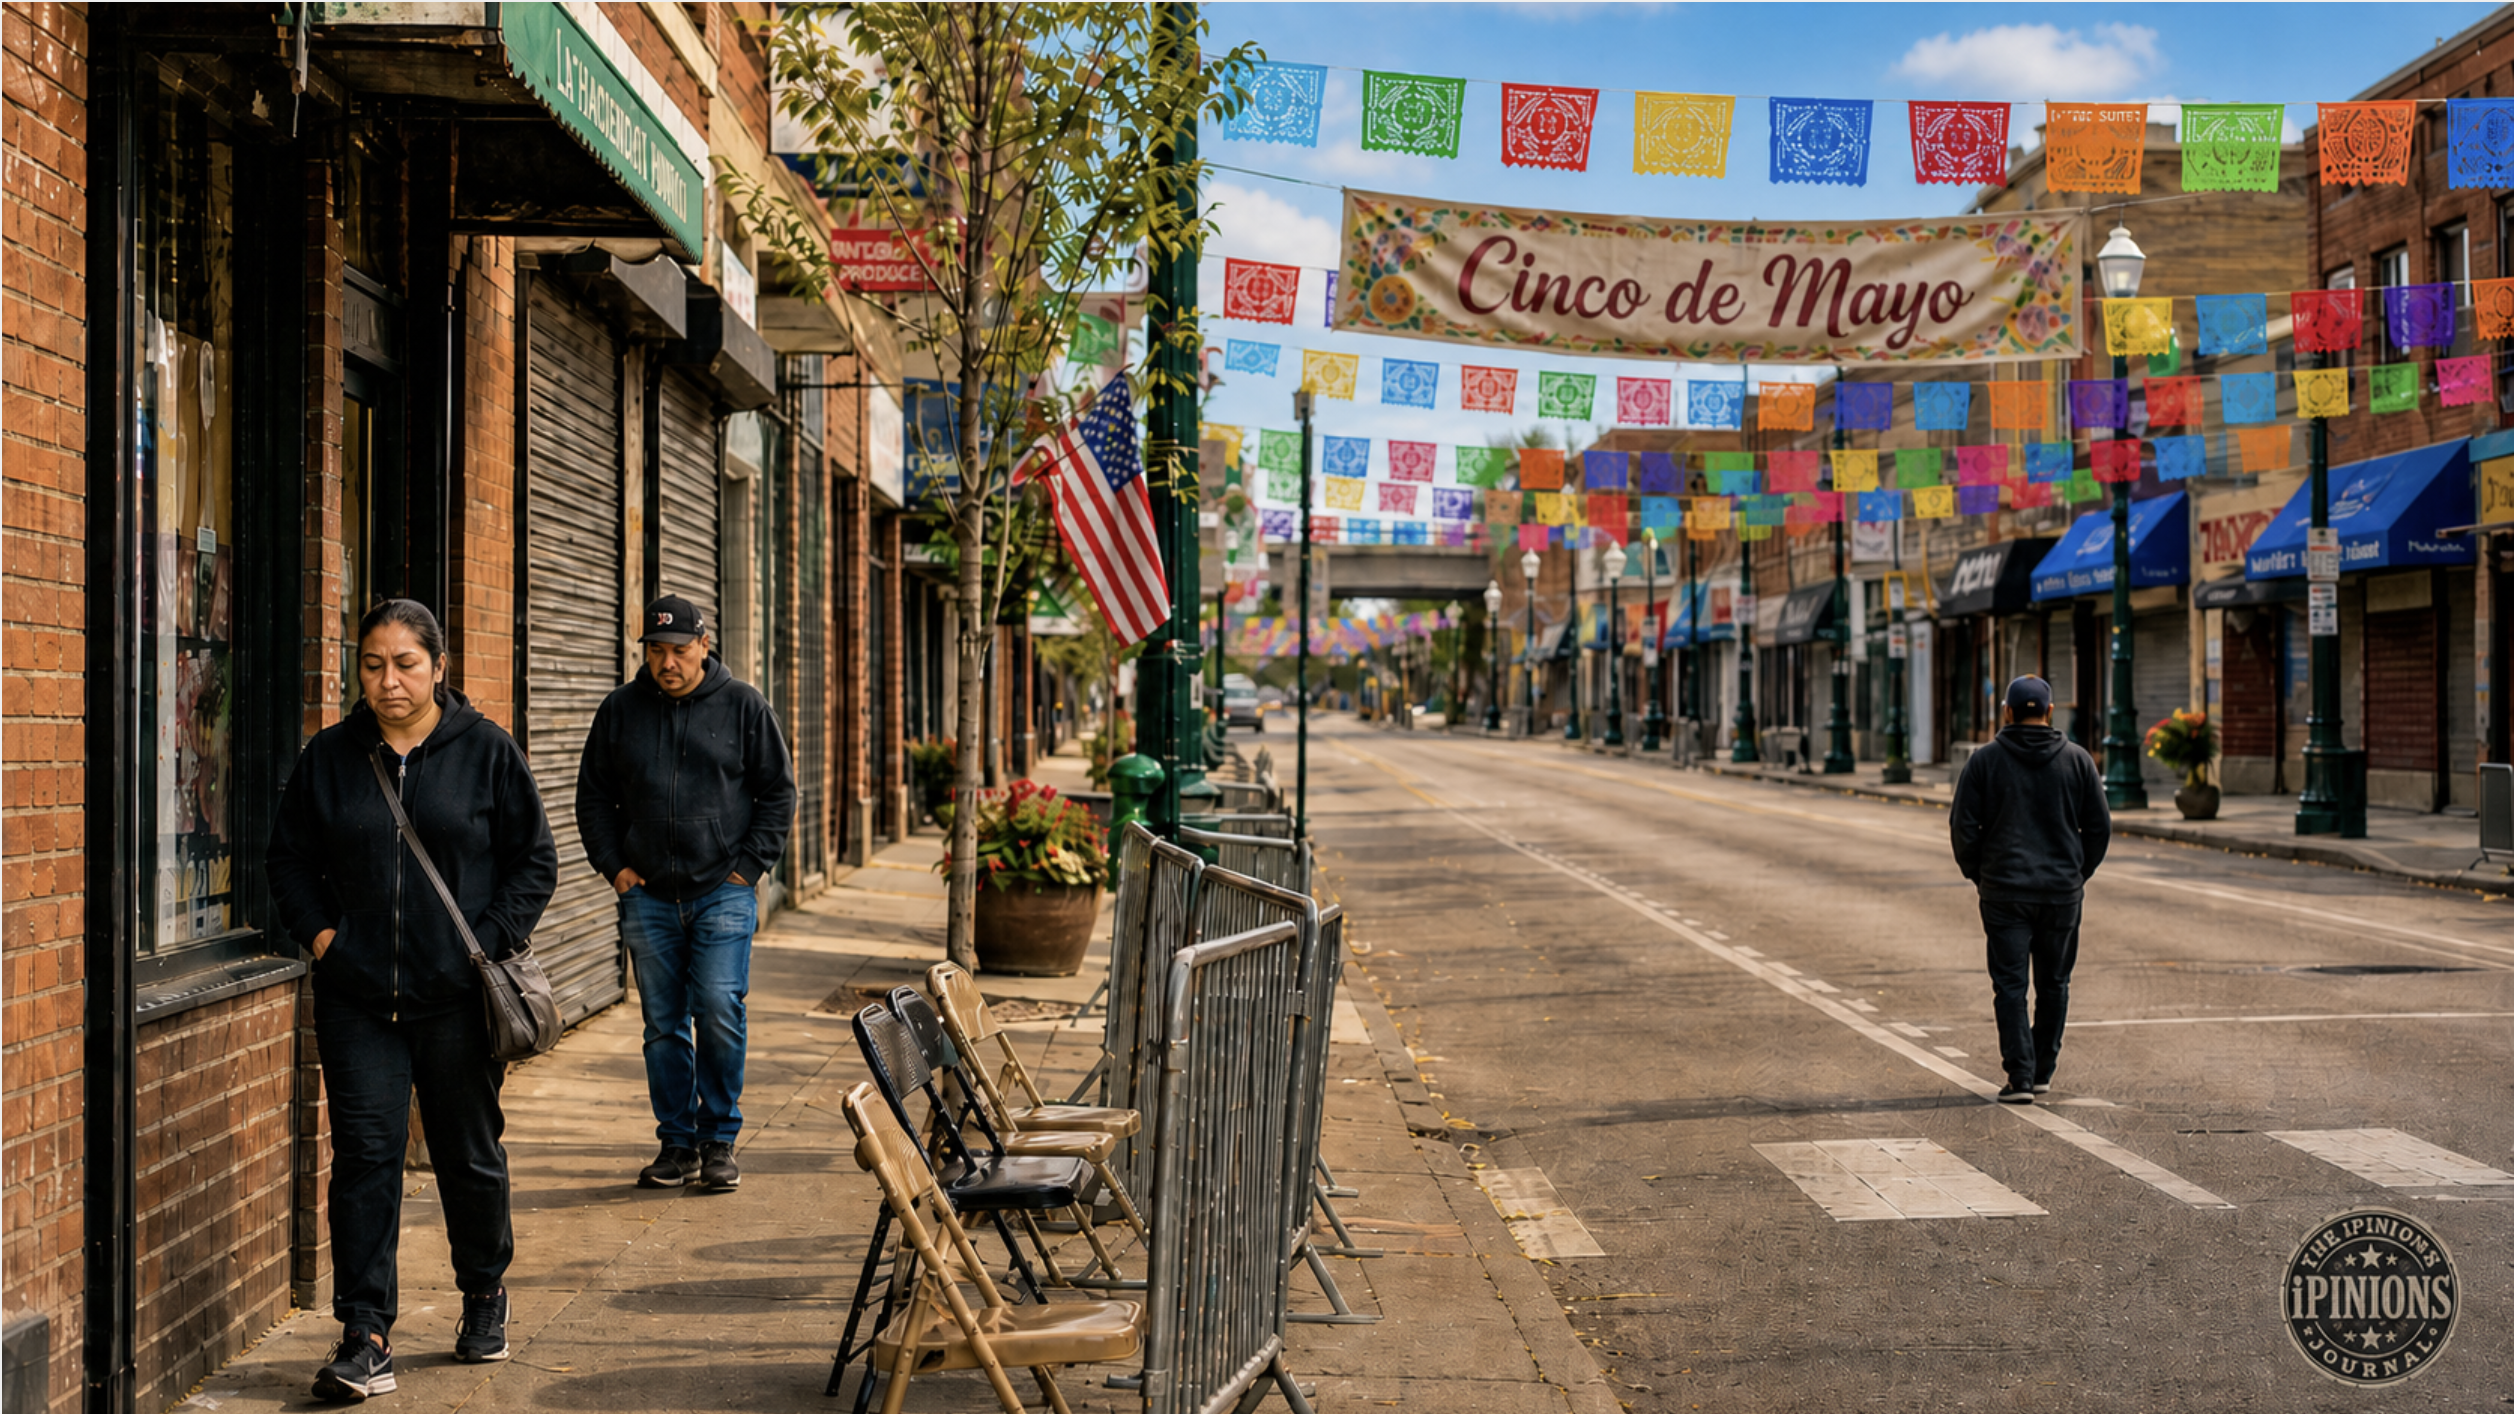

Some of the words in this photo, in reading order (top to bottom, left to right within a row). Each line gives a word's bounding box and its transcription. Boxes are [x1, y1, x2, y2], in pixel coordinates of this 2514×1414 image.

[1457, 235, 1651, 320] Cinco
[1664, 258, 1746, 326] de
[1762, 253, 1975, 350] Mayo
